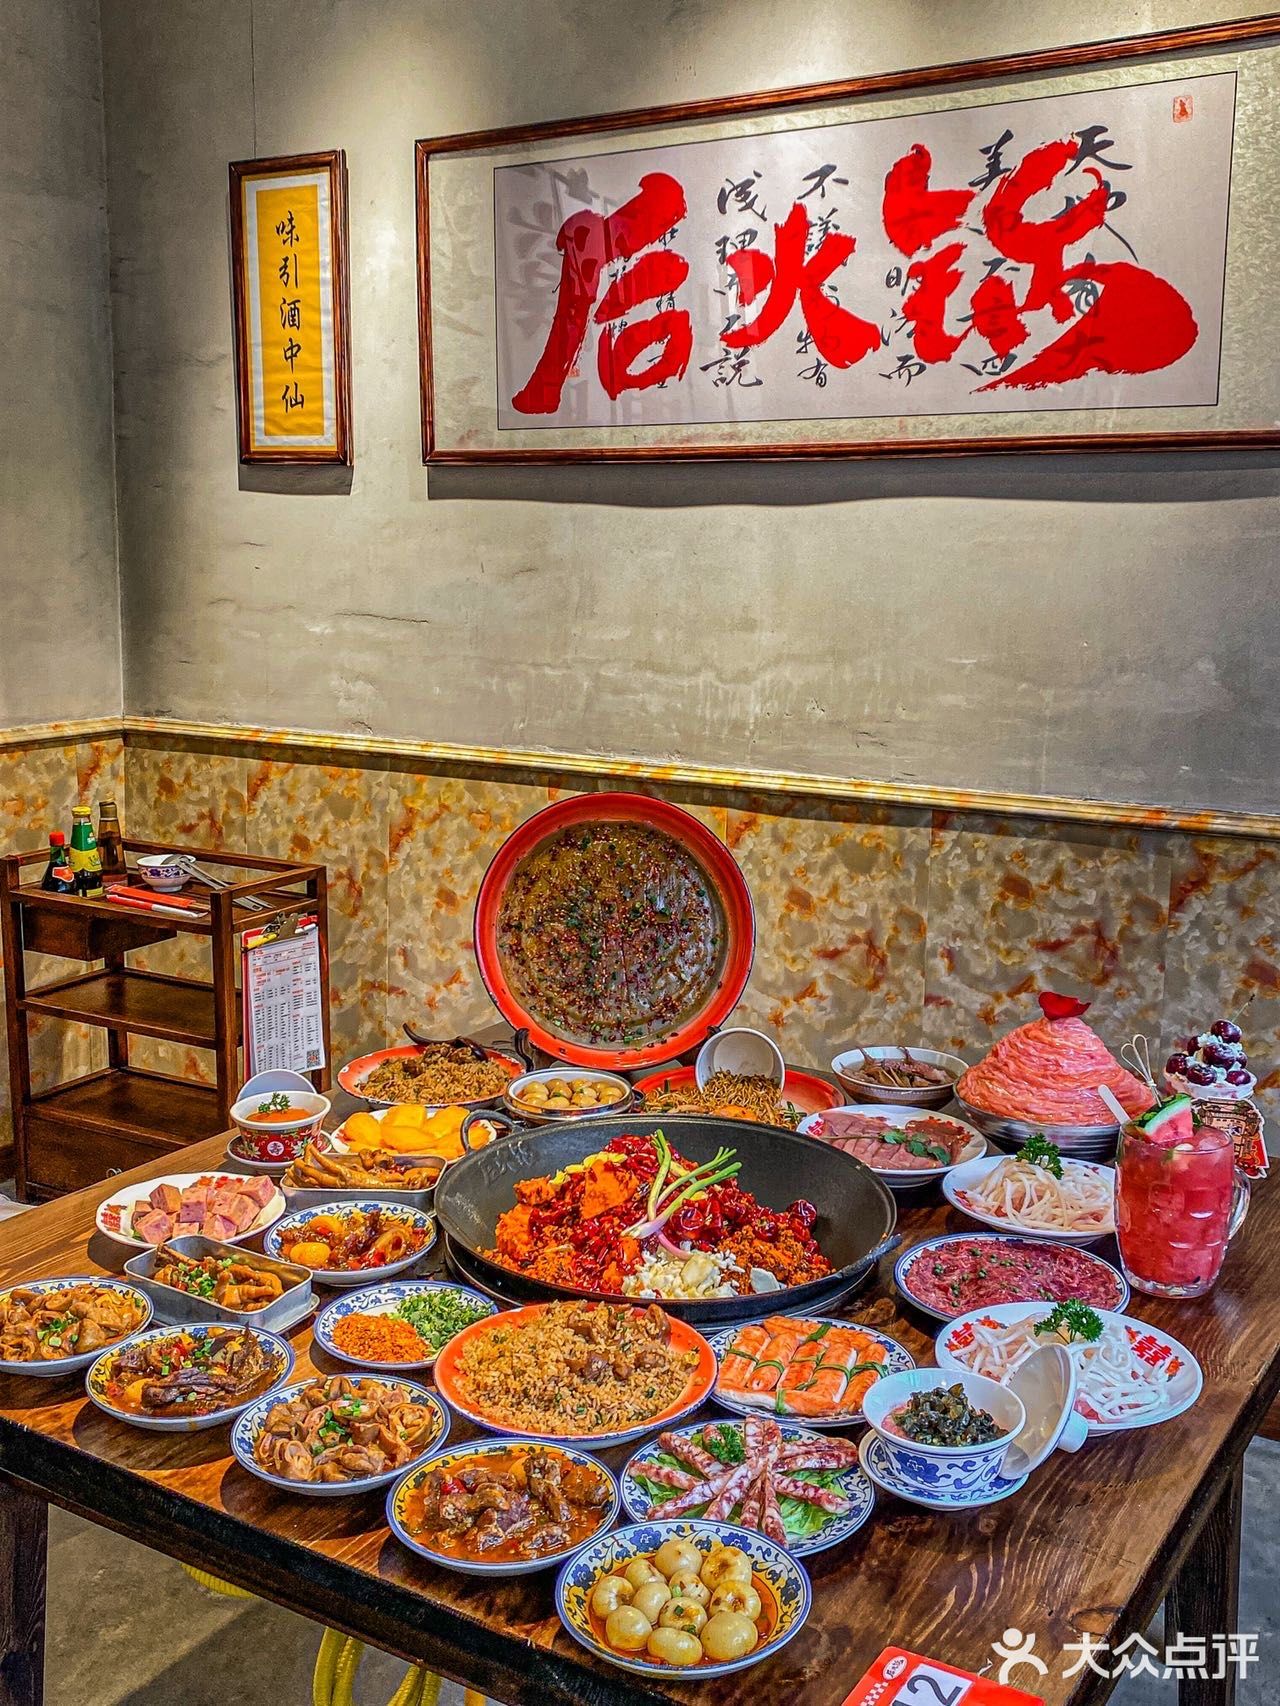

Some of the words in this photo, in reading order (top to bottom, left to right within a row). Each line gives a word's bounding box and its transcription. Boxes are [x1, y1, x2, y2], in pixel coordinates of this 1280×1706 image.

[275, 210, 305, 414] 味引酒中仙
[892, 1674, 963, 1706] 2
